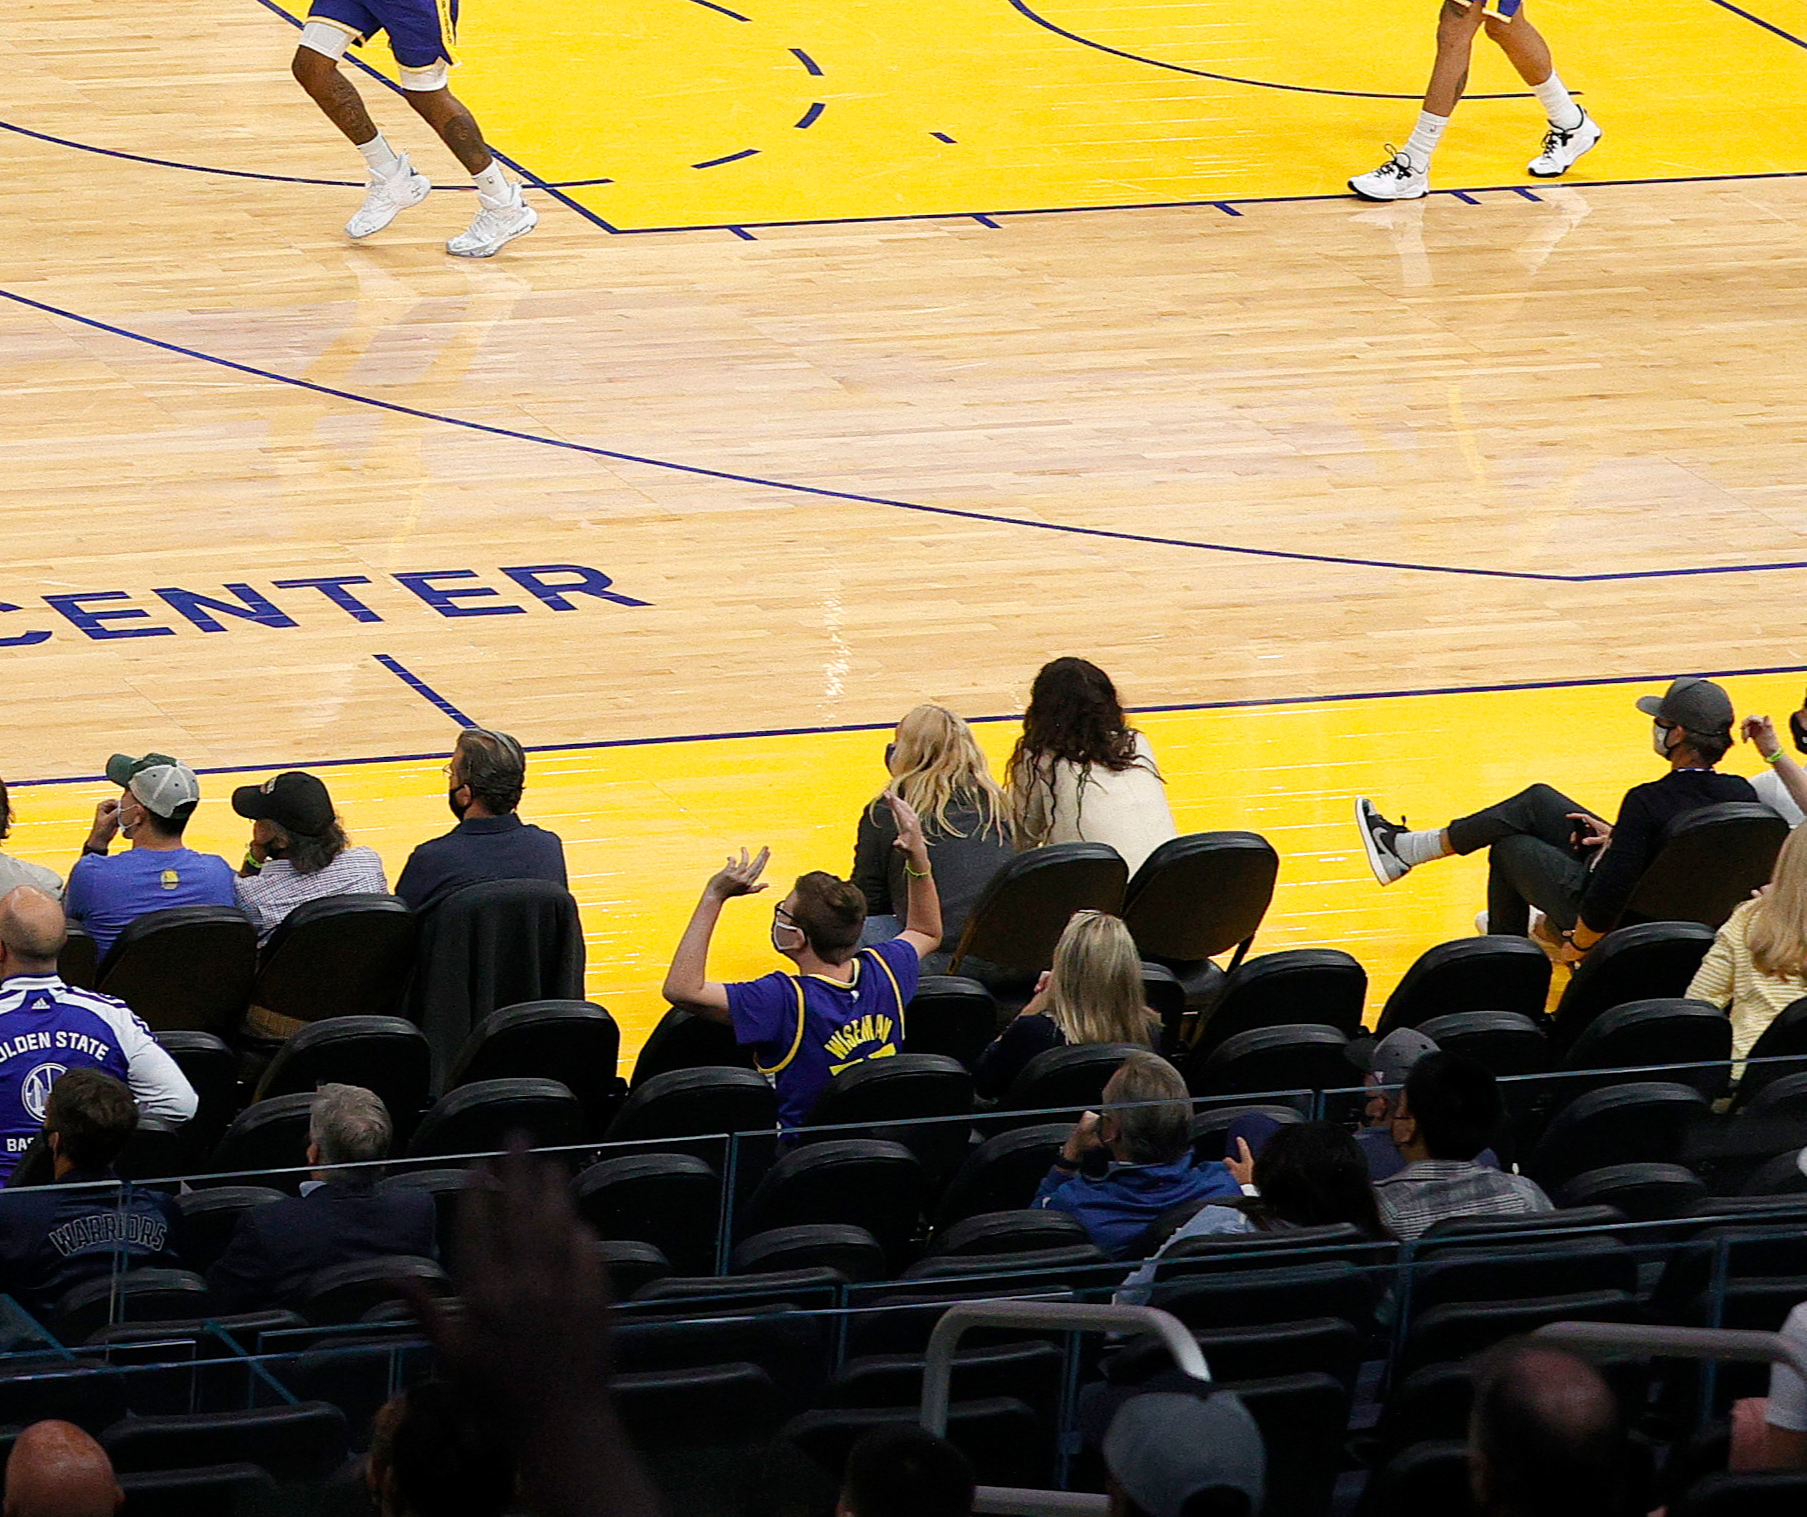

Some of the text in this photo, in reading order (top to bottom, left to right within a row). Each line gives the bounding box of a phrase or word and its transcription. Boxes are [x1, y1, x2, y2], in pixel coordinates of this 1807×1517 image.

[55, 1030, 110, 1064] STATE
[823, 1013, 896, 1061] WISEMAN
[48, 1211, 168, 1258] WARRIORS
